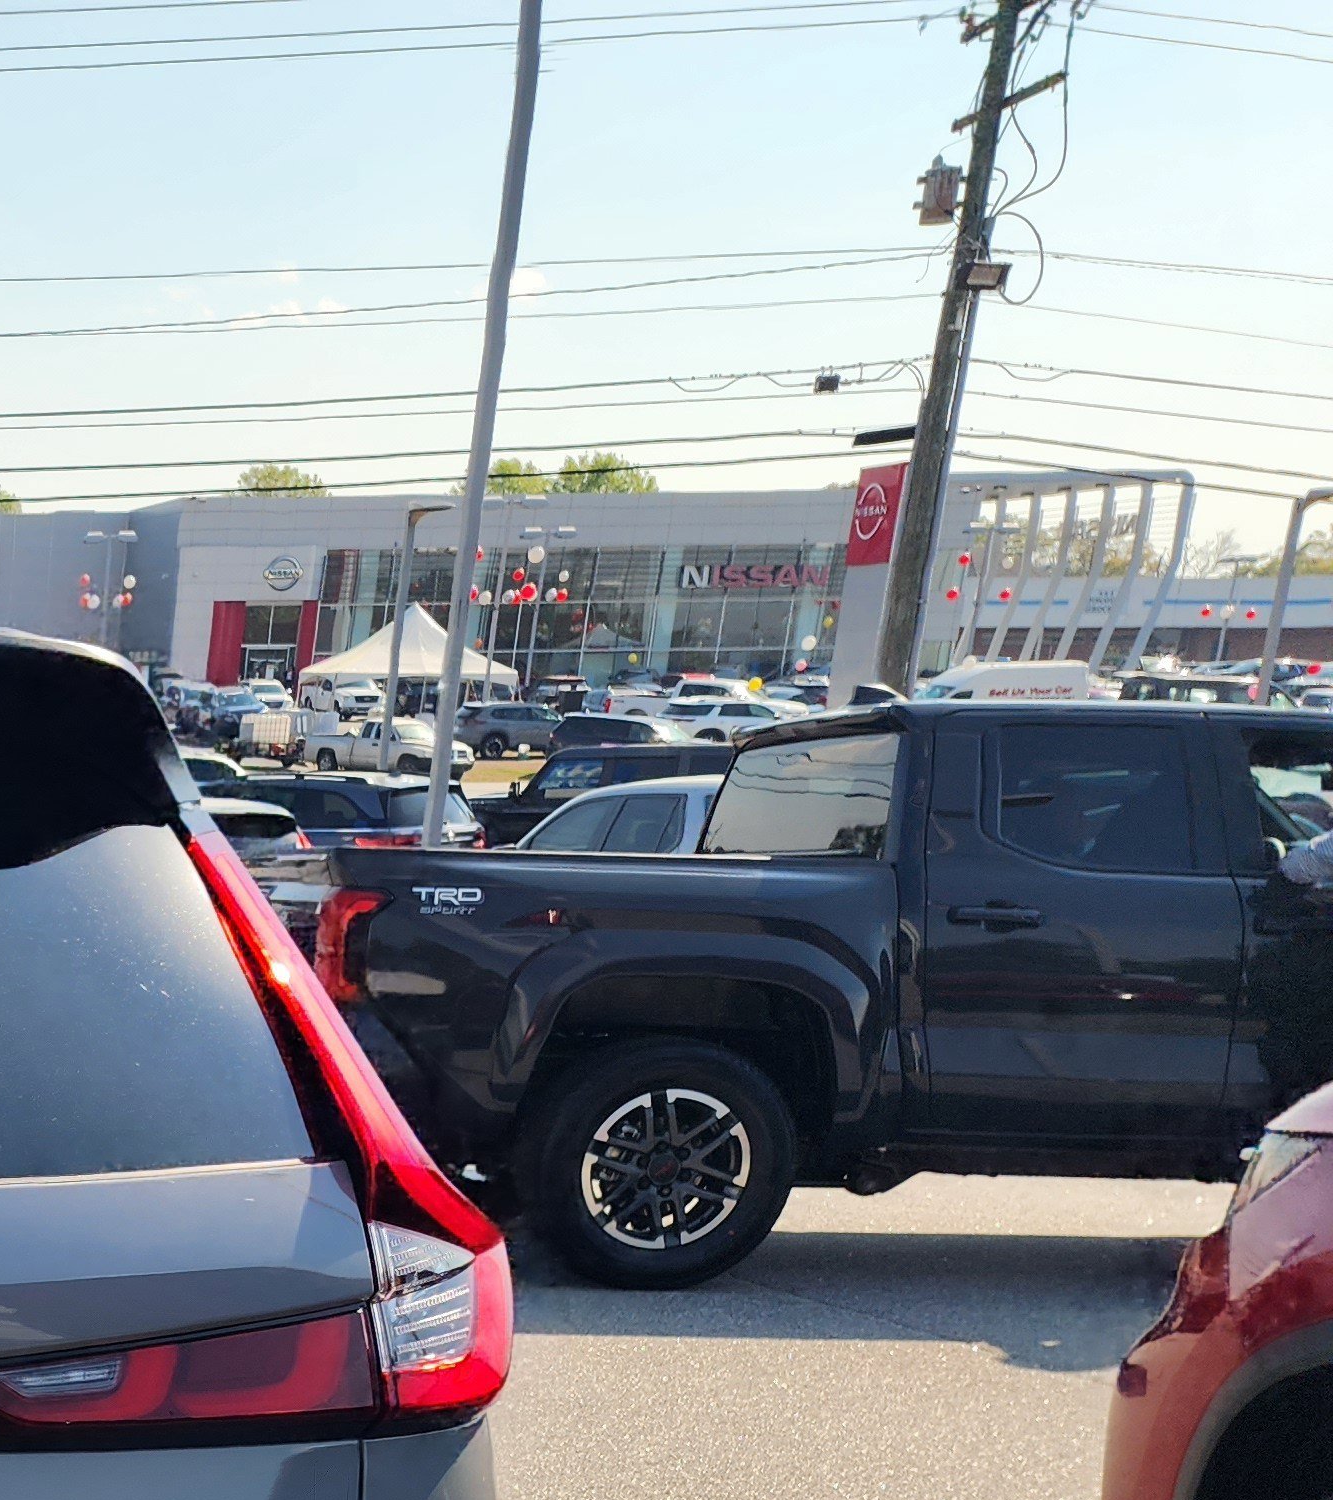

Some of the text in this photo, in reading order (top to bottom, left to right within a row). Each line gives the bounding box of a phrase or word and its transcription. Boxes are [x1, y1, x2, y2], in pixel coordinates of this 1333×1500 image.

[854, 505, 888, 517] NISSAN
[682, 565, 831, 588] NISSAN
[412, 887, 482, 906] TRD
